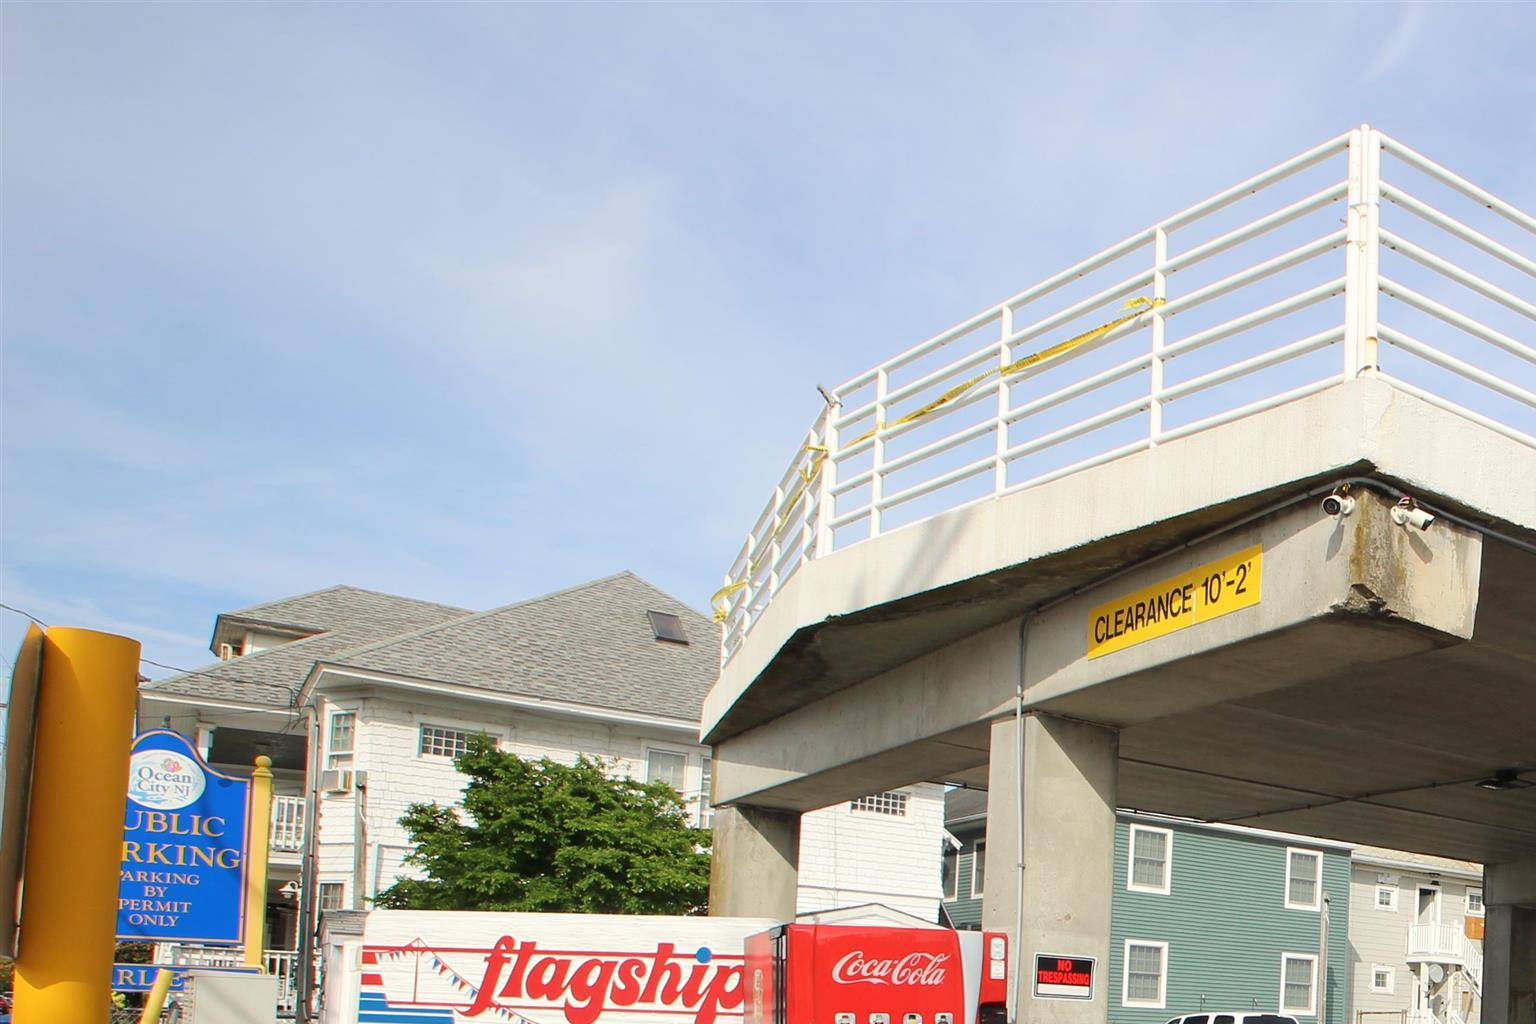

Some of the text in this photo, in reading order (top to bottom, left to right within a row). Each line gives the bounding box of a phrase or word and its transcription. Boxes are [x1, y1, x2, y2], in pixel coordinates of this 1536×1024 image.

[1094, 583, 1193, 644] CLEARANCE
[138, 766, 192, 784] Ocean
[137, 779, 190, 797] City NJ
[123, 809, 226, 837] UBLIC
[121, 841, 241, 869] RKING
[119, 870, 200, 886] ARKING
[143, 885, 168, 898] BY
[118, 898, 192, 913] PERMIT
[128, 913, 180, 927] ONLY
[831, 950, 951, 985] Coca-Cola
[1057, 959, 1073, 972] NO
[1038, 970, 1090, 985] TRESPASSING
